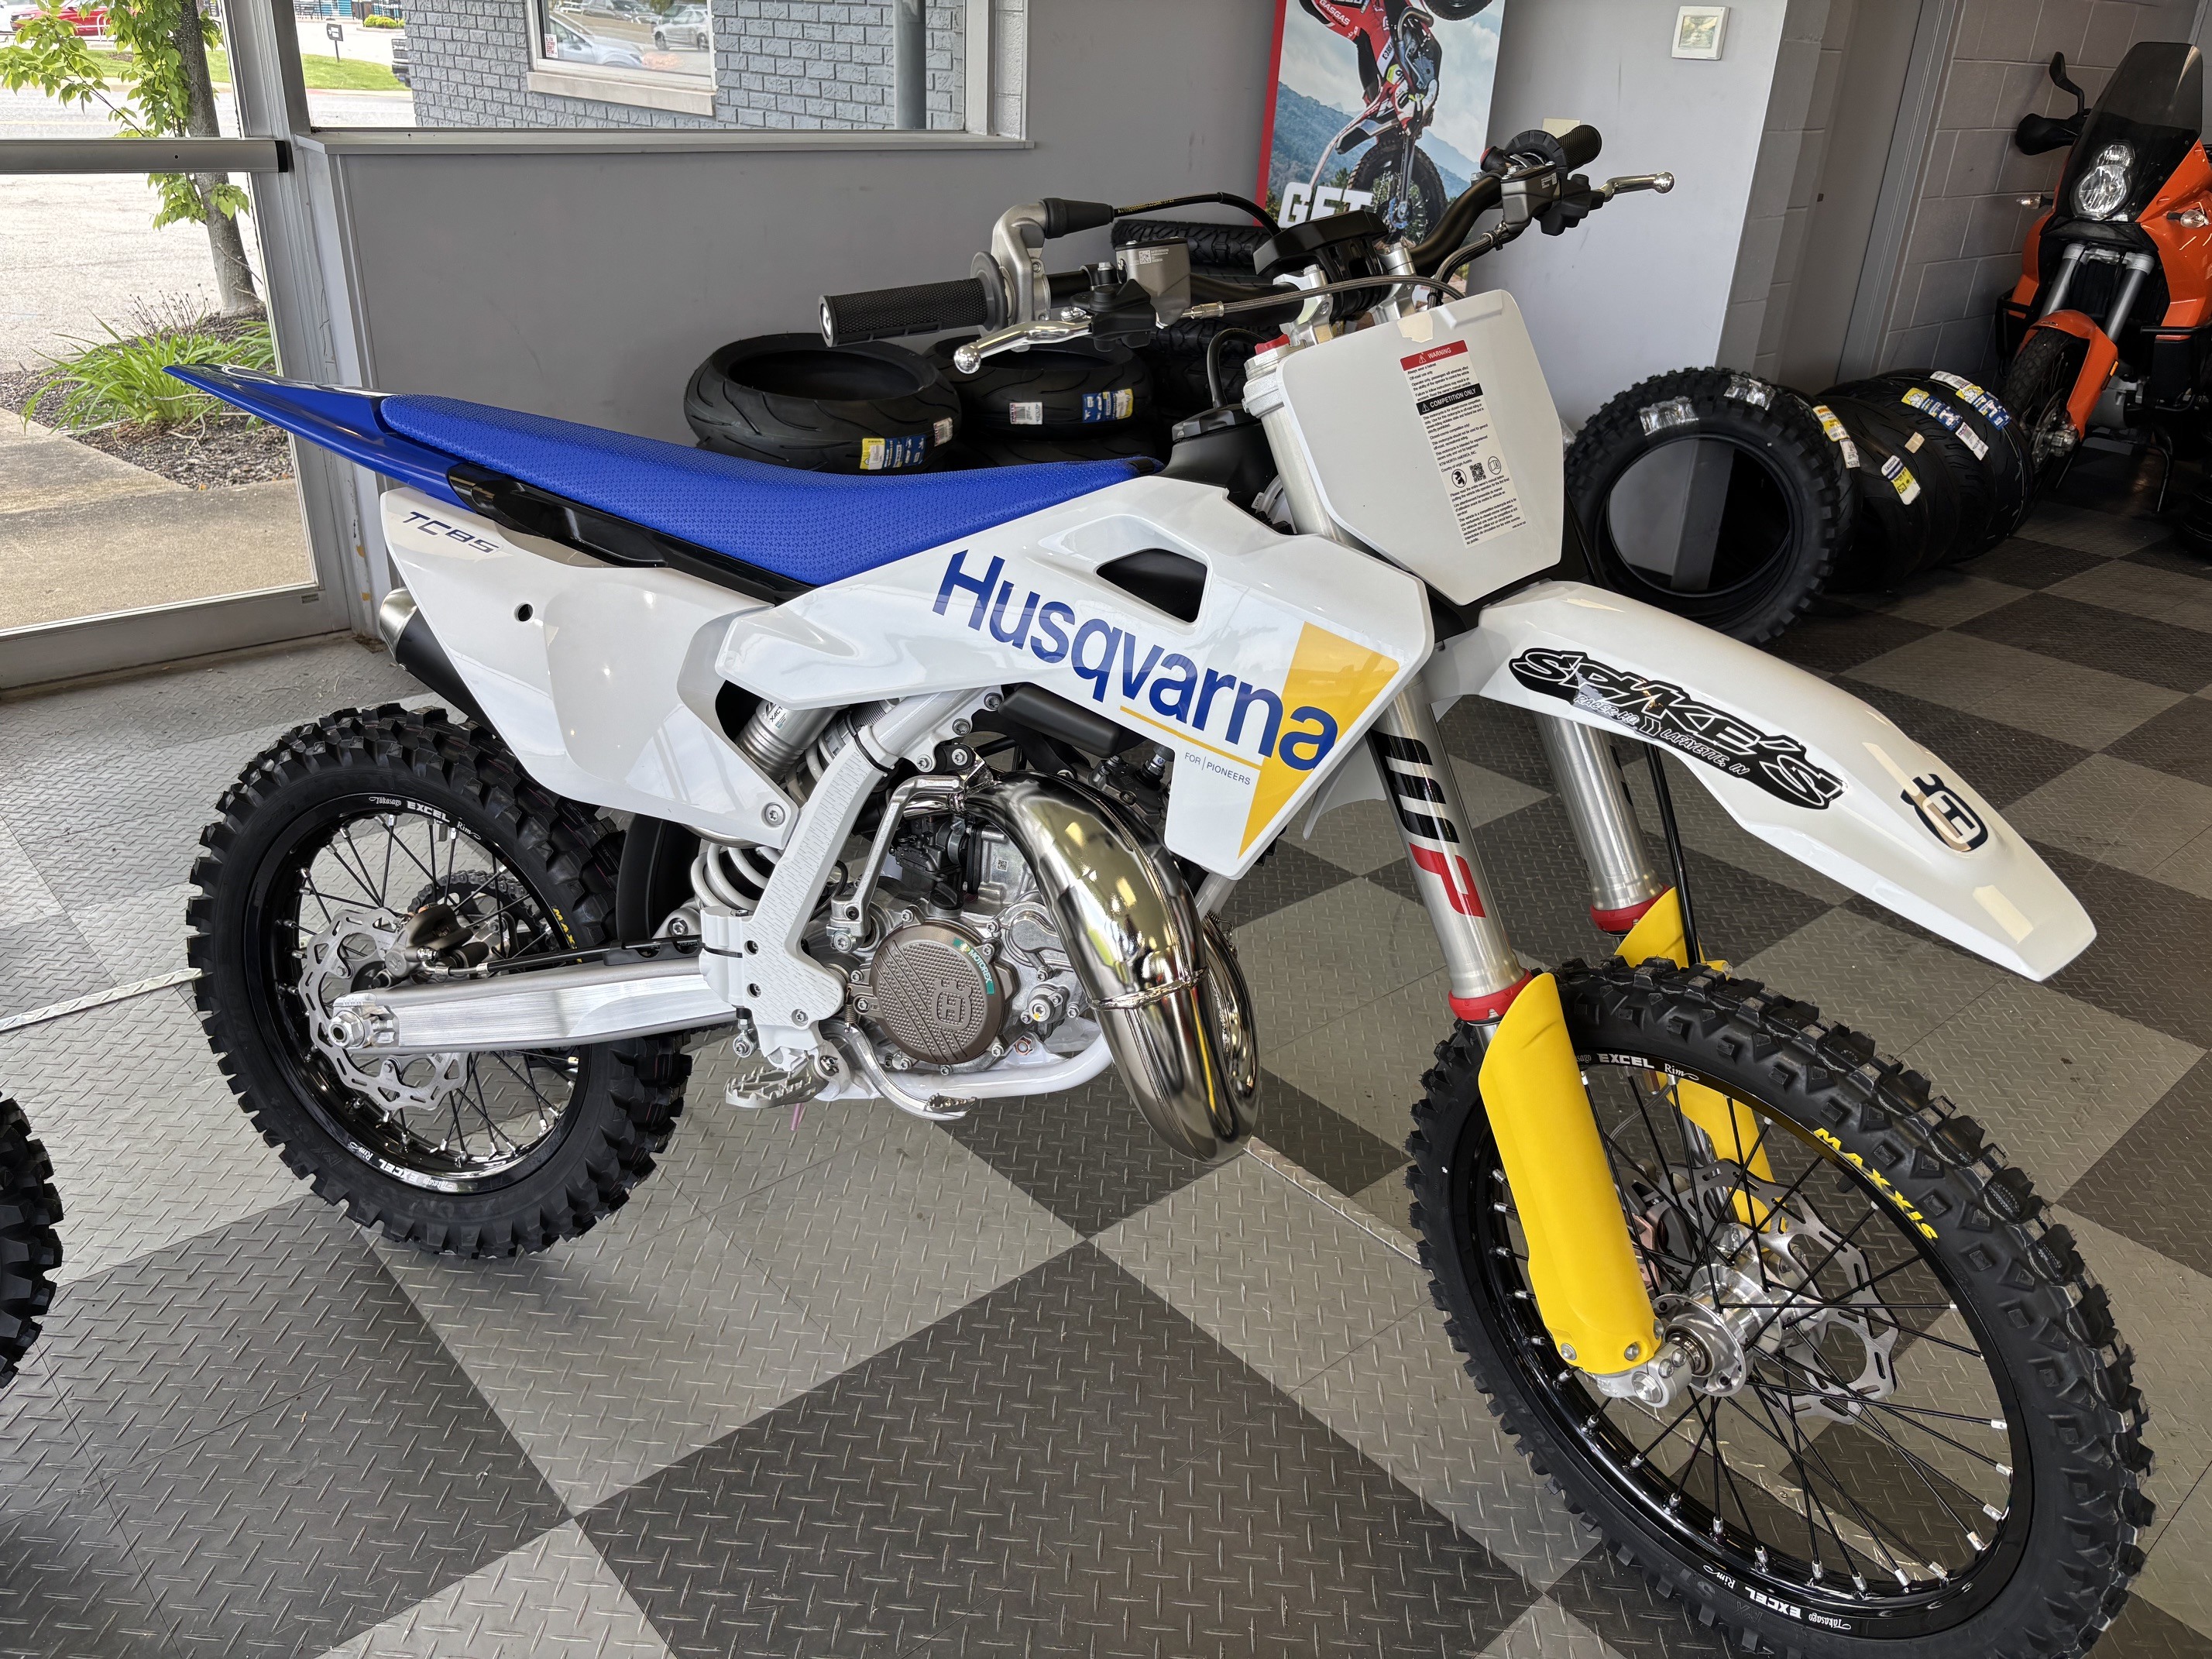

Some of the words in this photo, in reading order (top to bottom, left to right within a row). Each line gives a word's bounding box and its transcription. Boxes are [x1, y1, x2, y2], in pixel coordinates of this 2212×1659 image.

[1319, 0, 1351, 26] GASGAS
[1427, 347, 1451, 359] WARNING
[1430, 392, 1464, 407] COMPETITION
[1463, 388, 1475, 397] ONLY
[403, 511, 500, 553] TC85
[932, 549, 1338, 771] Husqvarna
[1574, 695, 1617, 716] RACER
[1618, 710, 1640, 726] HQ
[1728, 761, 1750, 775] IN
[1184, 752, 1201, 765] FOR
[1206, 761, 1251, 785] PIONEERS
[369, 796, 402, 807] Takasago
[407, 800, 450, 823] EXCEL
[456, 820, 482, 840] Rim
[968, 949, 993, 984] MOTOREX
[1596, 1053, 1655, 1069] EXCEL
[1664, 1063, 1699, 1080] Rim
[349, 1141, 374, 1161] Rim
[380, 1159, 419, 1182] EXCEL
[1813, 1128, 1939, 1245] MAXXIS
[1703, 1565, 1736, 1589] Rim
[1744, 1586, 1802, 1620] EXCEL
[1808, 1612, 1851, 1630] Takasago
